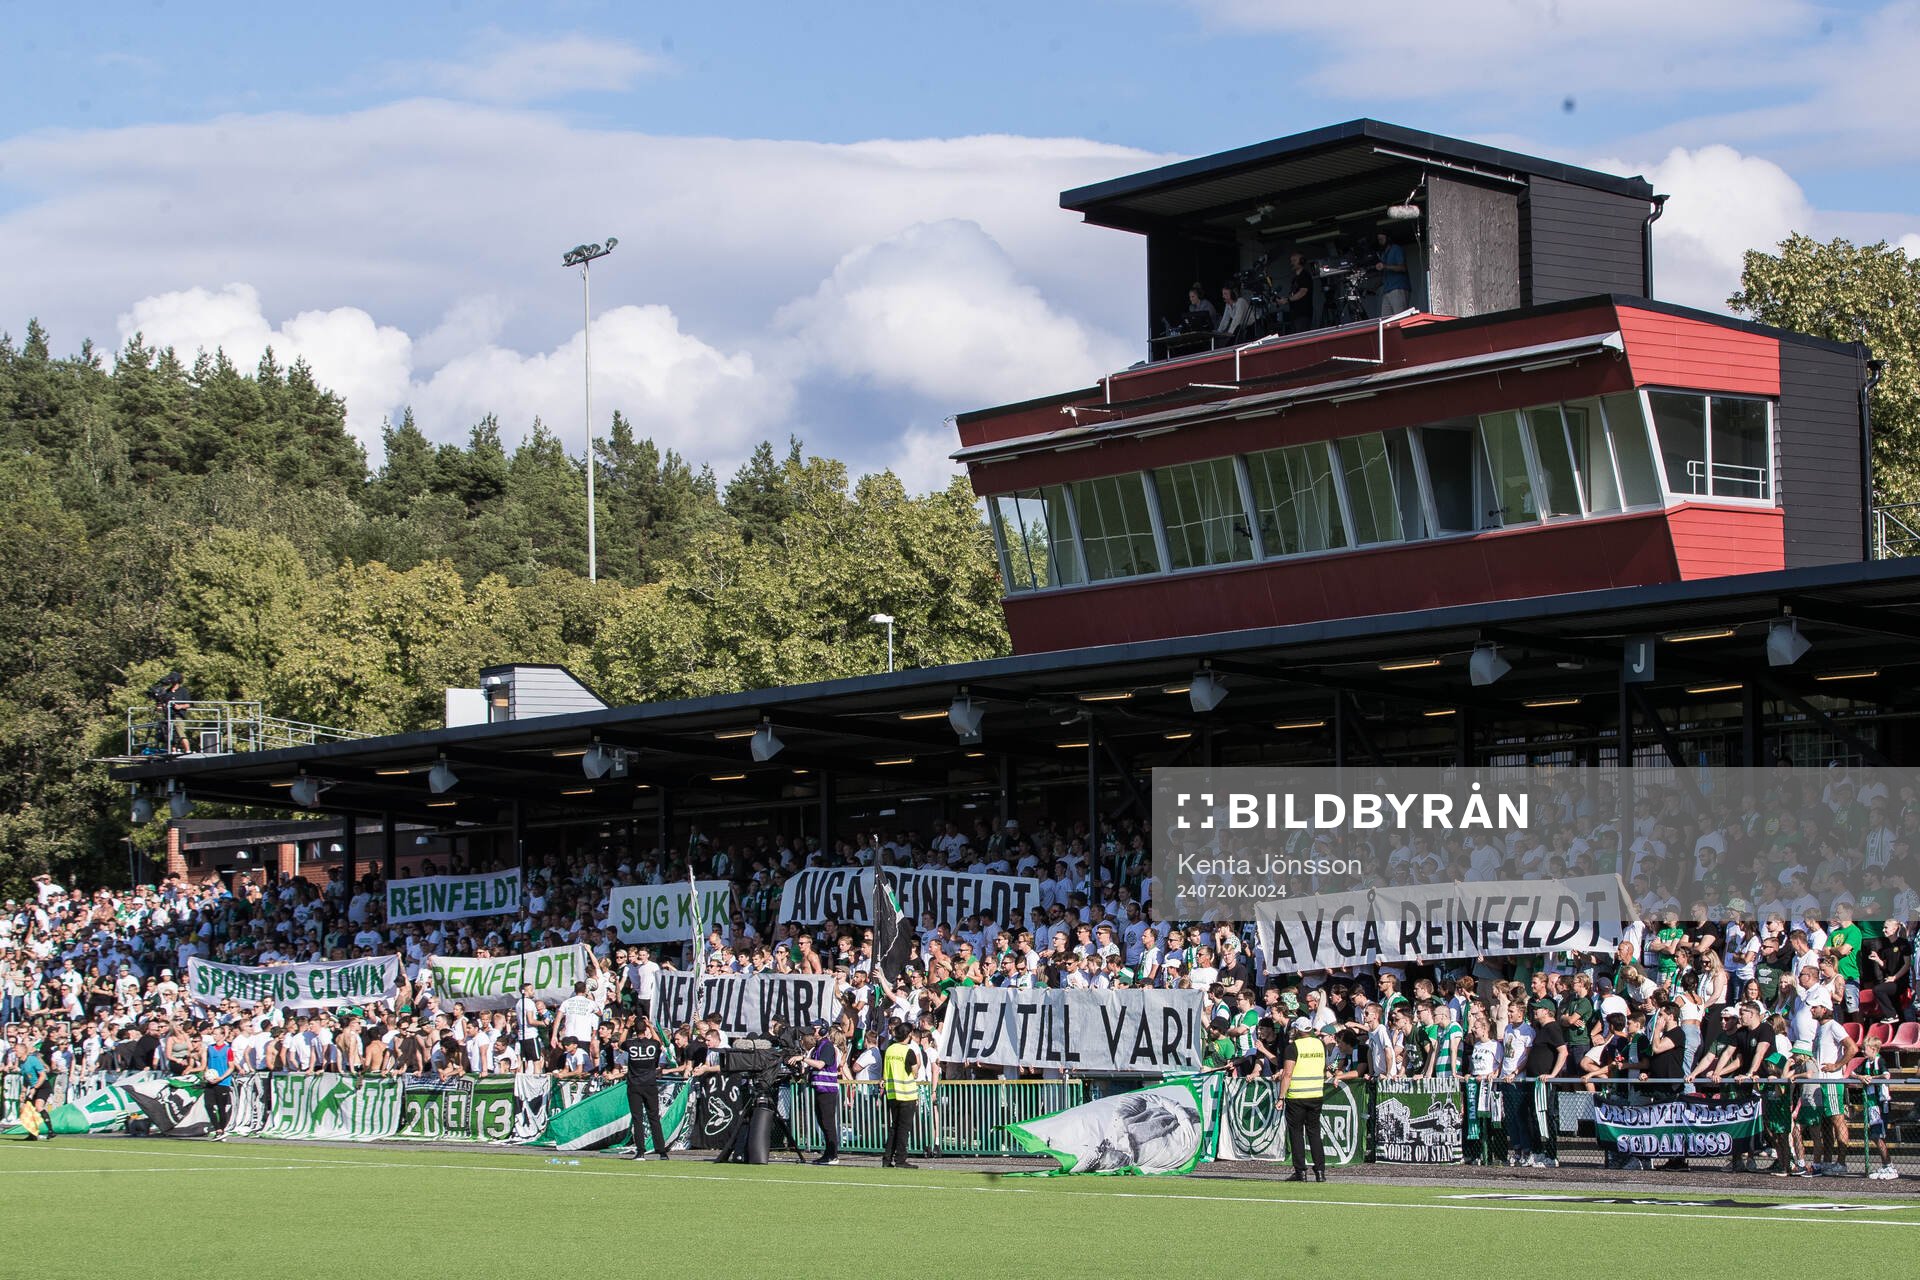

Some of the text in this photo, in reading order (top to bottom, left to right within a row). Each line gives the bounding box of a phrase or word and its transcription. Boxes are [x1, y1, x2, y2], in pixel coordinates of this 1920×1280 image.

[1632, 643, 1645, 673] J
[621, 895, 669, 934] SUG
[1272, 889, 1383, 967] AVGÅ
[197, 963, 386, 1001] SPORTENS CLOWN
[629, 1045, 657, 1058] SLO
[946, 1002, 1193, 1067] NEJ TILL VAR!
[401, 1100, 440, 1137] 20
[475, 1098, 512, 1141] 13
[1415, 1145, 1429, 1162] OM
[1431, 1144, 1454, 1162] STAN
[1617, 1131, 1733, 1156] SEDAN 1889
